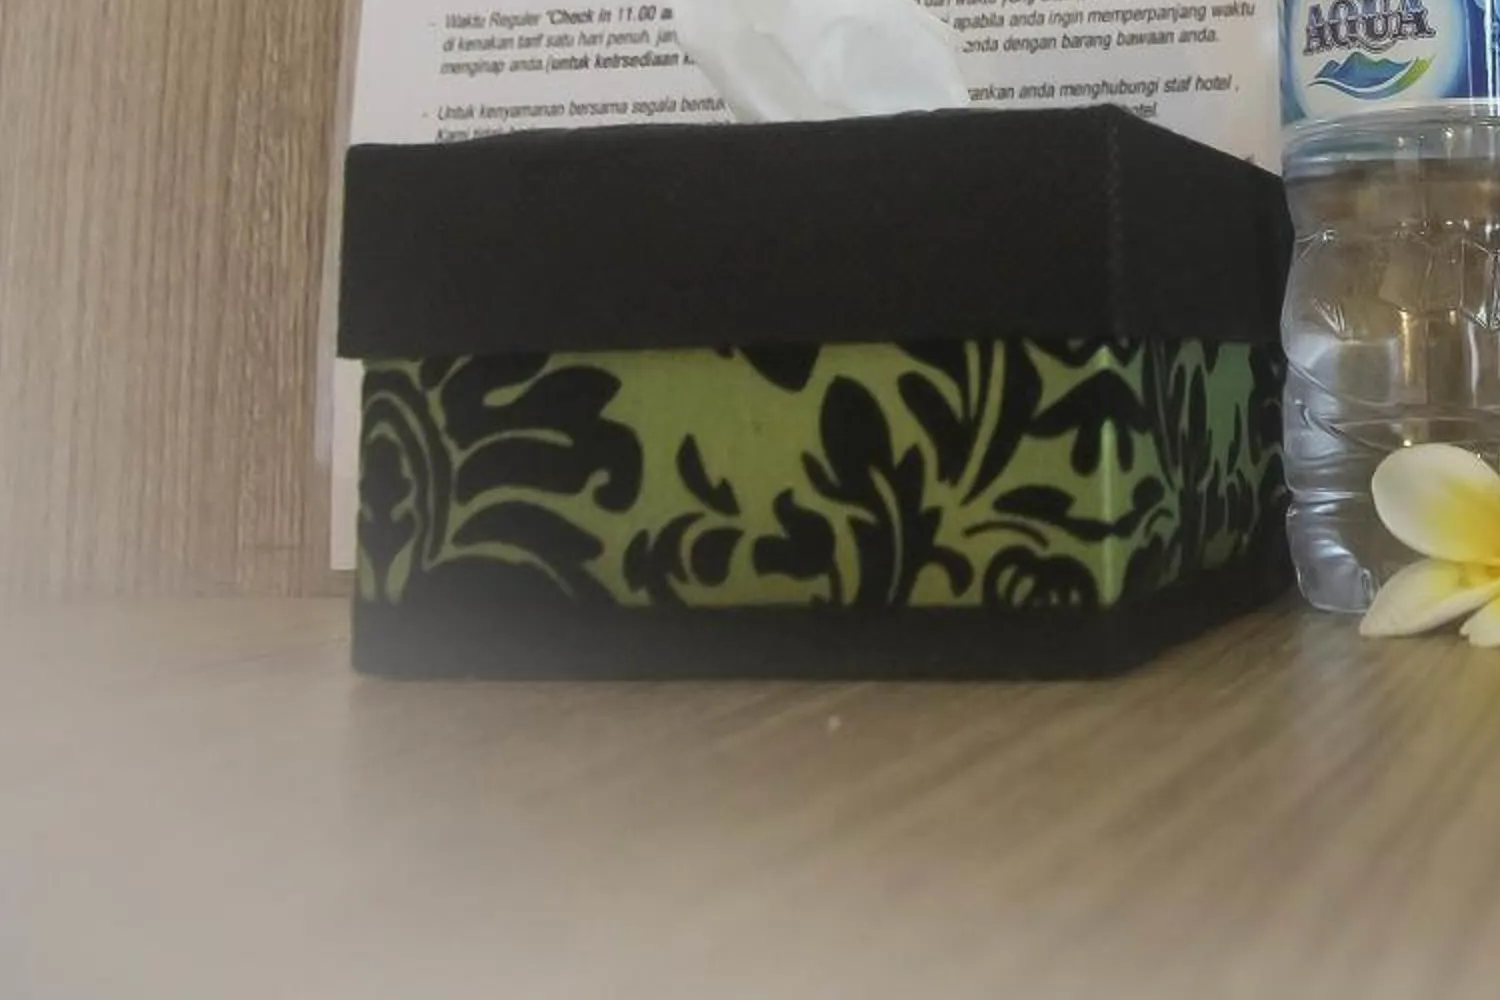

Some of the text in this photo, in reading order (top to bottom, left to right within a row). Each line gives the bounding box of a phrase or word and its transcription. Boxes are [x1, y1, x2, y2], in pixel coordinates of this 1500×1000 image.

[577, 31, 605, 47] hari
[1008, 9, 1046, 28] anda
[1211, 0, 1256, 18] waktu
[597, 7, 612, 23] in
[1002, 34, 1057, 55] dengan
[1061, 33, 1113, 51] barang
[1115, 30, 1175, 47] bawaan
[437, 104, 476, 121] Untuk
[478, 103, 566, 122] kenyamanan
[568, 100, 629, 117] bersama
[1018, 81, 1056, 99] anda
[1194, 74, 1233, 92] hotel
